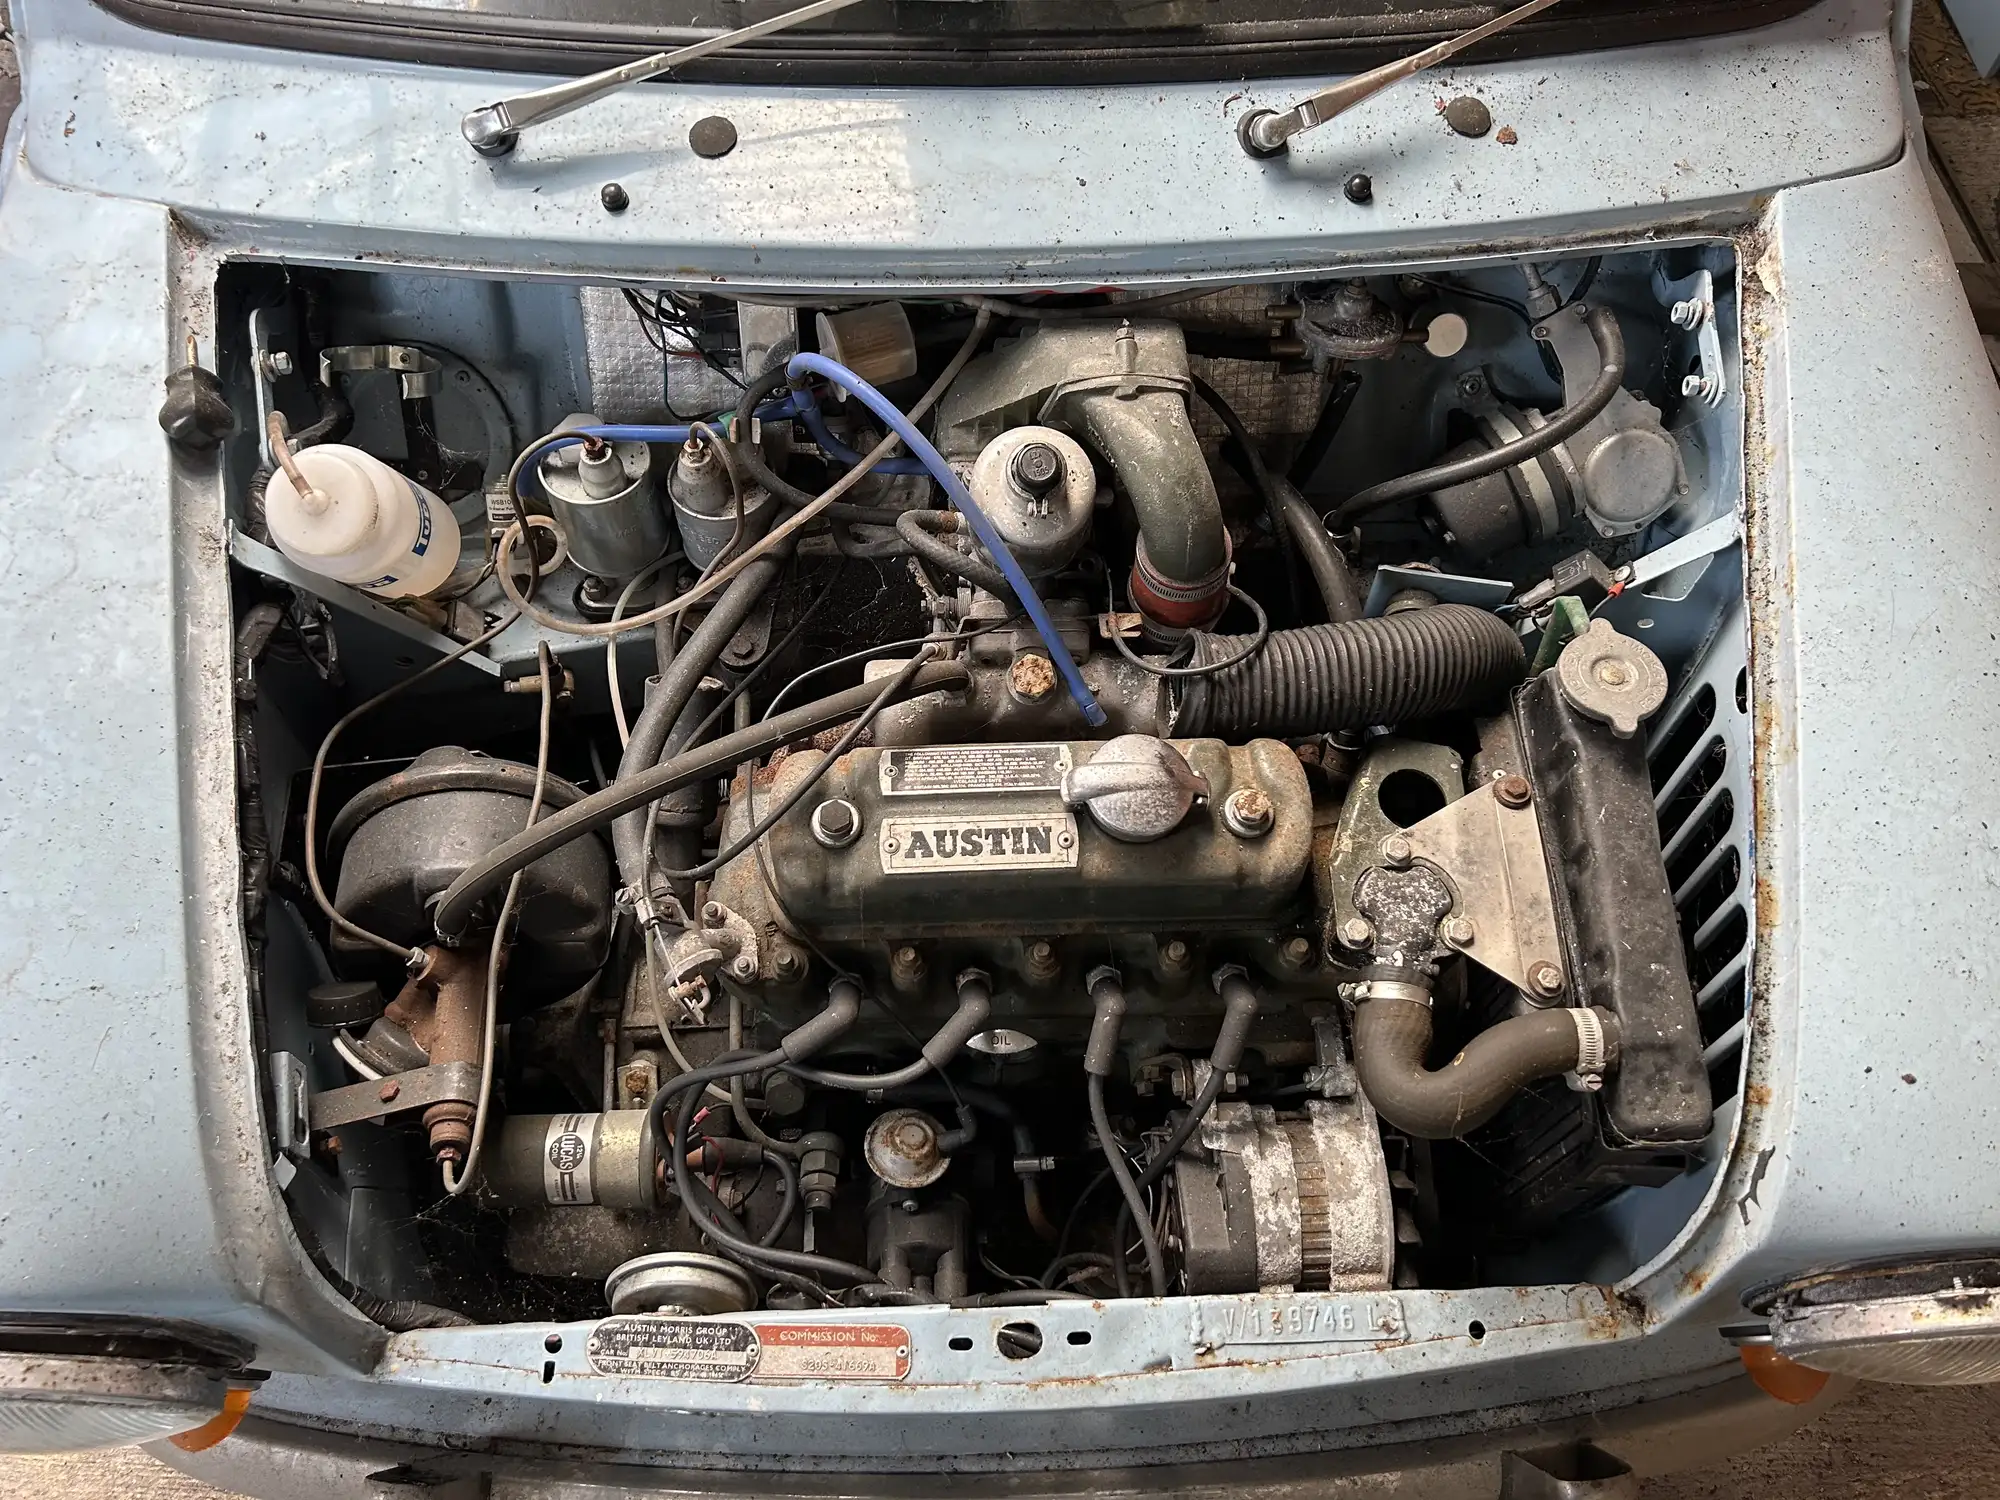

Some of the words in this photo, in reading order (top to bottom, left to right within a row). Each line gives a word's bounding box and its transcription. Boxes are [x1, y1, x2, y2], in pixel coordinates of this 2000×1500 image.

[905, 826, 1052, 859] AUSTIN
[991, 1035, 1011, 1045] OIL
[551, 1142, 559, 1161] COIL
[560, 1135, 576, 1169] LUCAS
[624, 1323, 656, 1332] AUSTIN
[660, 1325, 692, 1333] MORRIS
[696, 1326, 727, 1335] GROUP
[616, 1332, 649, 1342] BRITISH
[652, 1335, 691, 1343] LEYLAND
[779, 1329, 856, 1342] COMMISSION
[661, 1362, 713, 1370] ANCHORAGES
[715, 1364, 745, 1372] COMPLY
